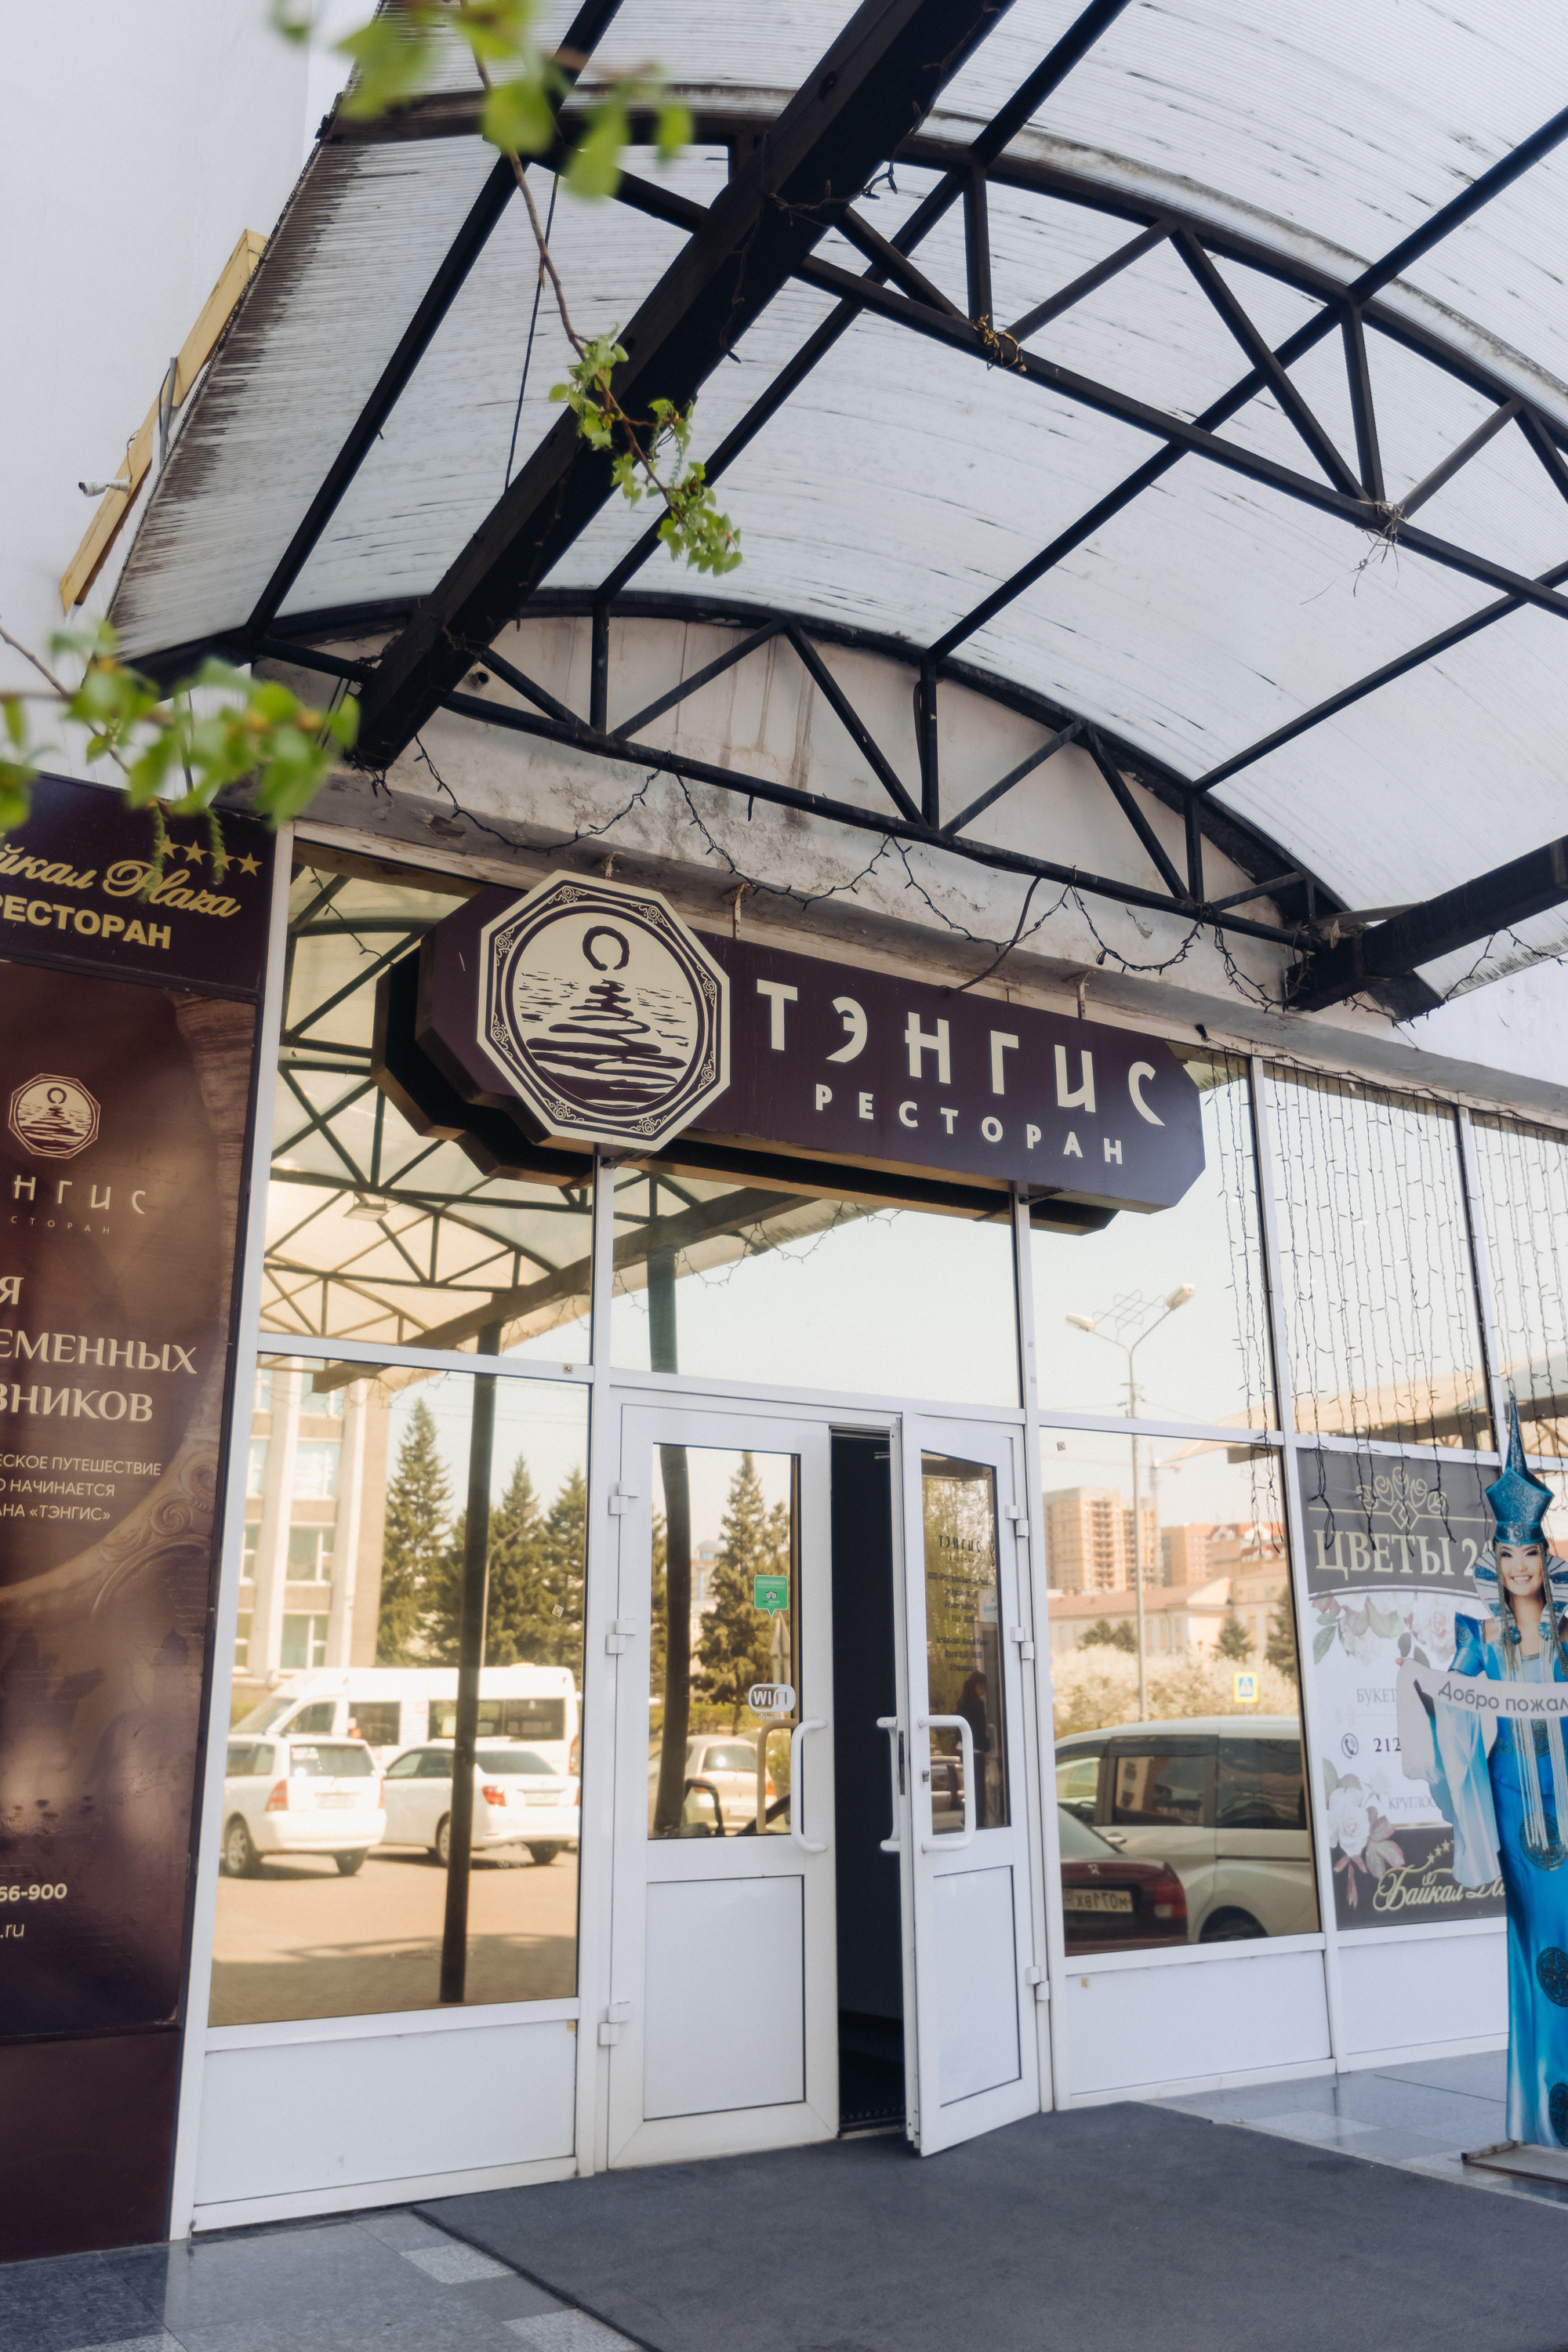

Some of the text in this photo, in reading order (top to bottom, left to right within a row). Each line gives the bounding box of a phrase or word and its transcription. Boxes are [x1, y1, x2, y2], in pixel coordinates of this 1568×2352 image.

[103, 860, 241, 917] Plaza
[0, 894, 172, 949] ЕСТОРАН
[757, 978, 1166, 1126] ТЭНГИС
[815, 1083, 1124, 1166] РЕСТОРАН
[14, 1174, 147, 1214] НГИС
[11, 1215, 110, 1234] СТОРАН
[52, 1457, 162, 1476] ПУТЕШЕСТВИЕ
[10, 1478, 115, 1497] НАЧИНАЕТСЯ
[0, 1502, 111, 1522] НА «ТЭНГИС»
[938, 1534, 981, 1552] ТЭНГИС
[1312, 1529, 1494, 1581] ЦВЕТЫ 2
[1438, 1681, 1499, 1709] Добро
[1373, 1861, 1463, 1911] Байкал
